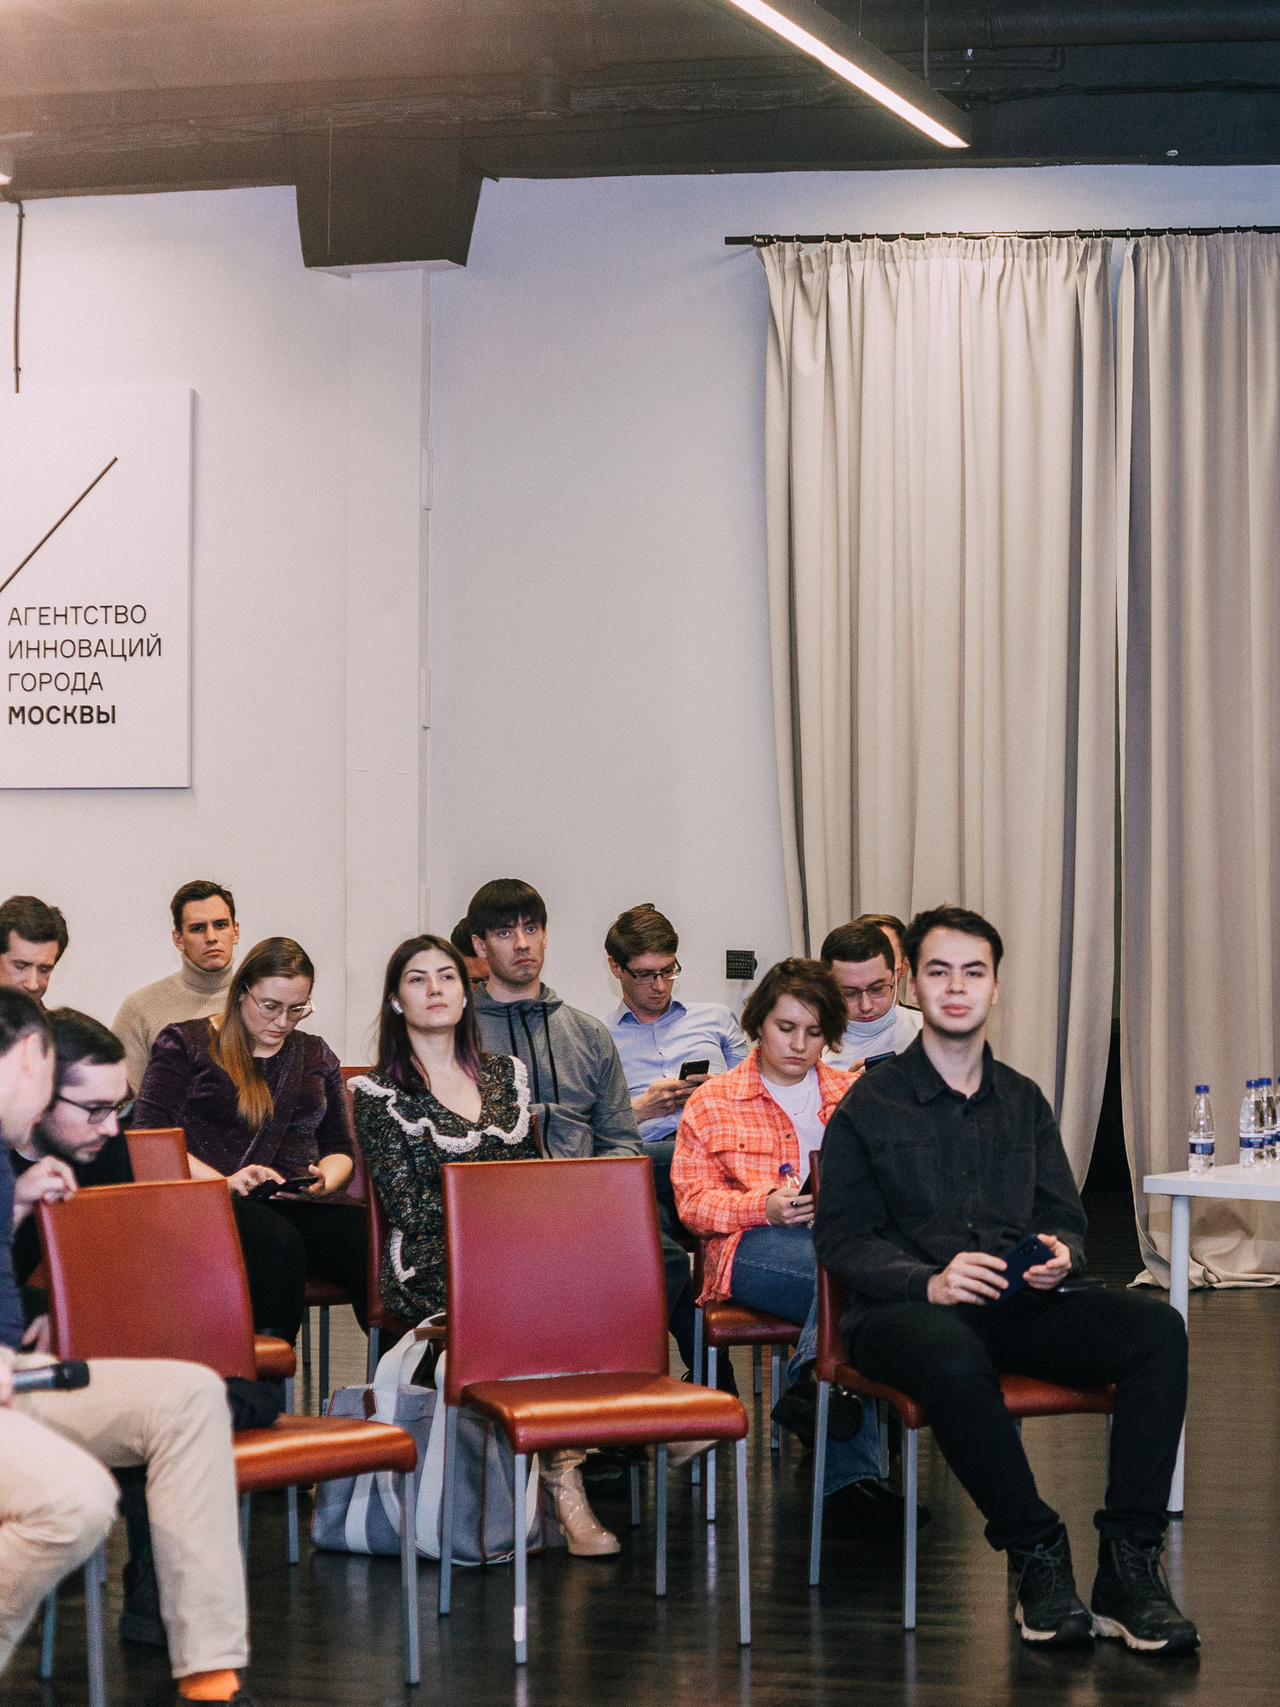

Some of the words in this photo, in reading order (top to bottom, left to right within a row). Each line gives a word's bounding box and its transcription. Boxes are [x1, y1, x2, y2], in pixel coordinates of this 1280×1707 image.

[7, 604, 147, 626] АГЕНТСТВО
[7, 632, 162, 661] ИННОВАЦИЙ
[7, 672, 104, 695] ГОРОДА
[7, 705, 117, 725] МОСКВЫ
